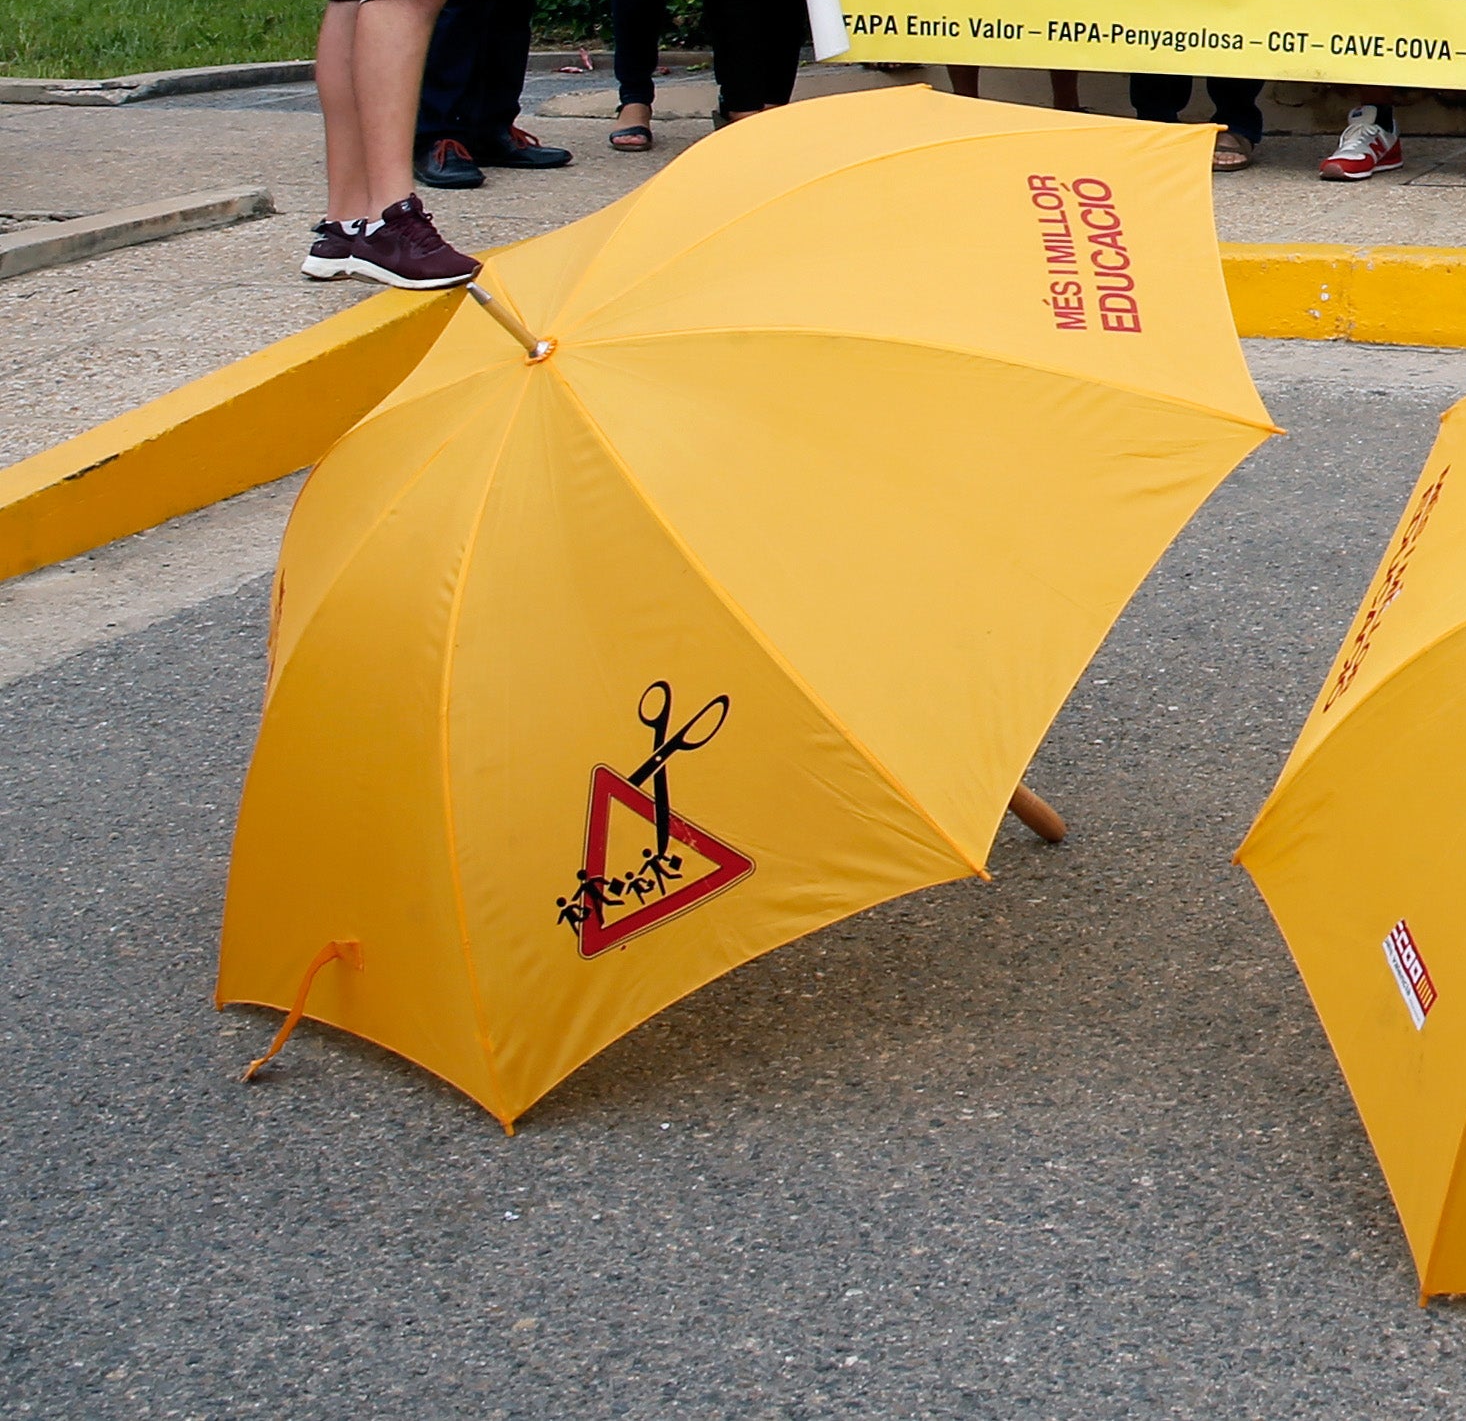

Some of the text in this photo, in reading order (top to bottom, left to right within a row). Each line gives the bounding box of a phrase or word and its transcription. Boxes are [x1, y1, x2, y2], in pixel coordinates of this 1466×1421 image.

[844, 14, 899, 36] FAPA
[907, 16, 960, 38] Enric
[969, 18, 1024, 40] Valor
[1047, 21, 1244, 52] FAPA-Penyagolosa
[1267, 31, 1309, 53] CGT
[1331, 34, 1451, 61] CAVE-COVA
[1027, 174, 1077, 264] MILLOR
[1060, 178, 1142, 333] EDUCACIÓ
[1042, 280, 1088, 330] MÉS
